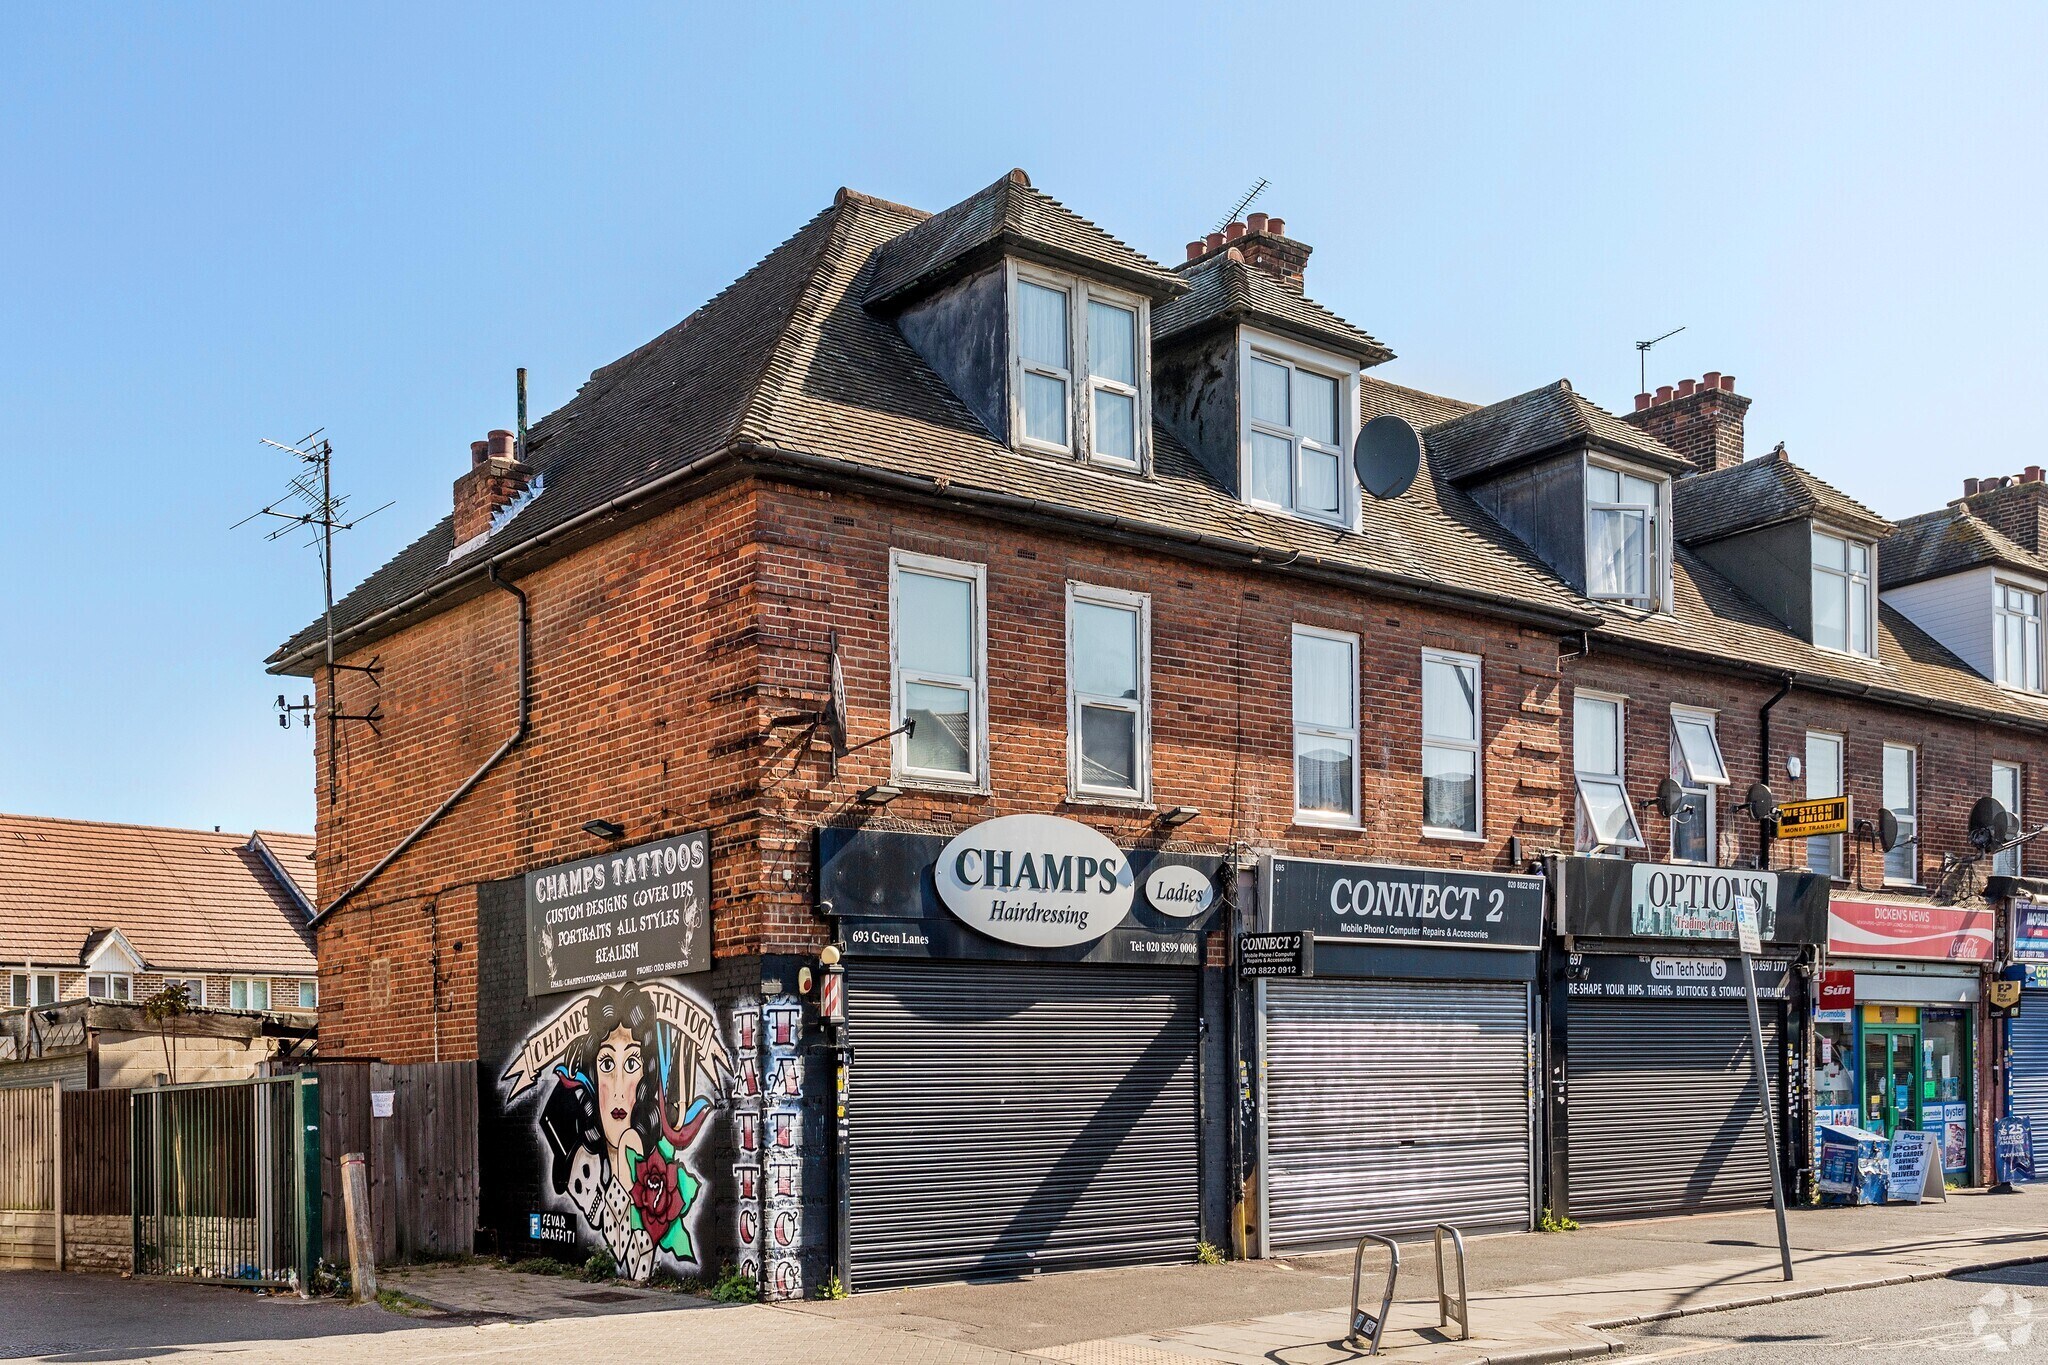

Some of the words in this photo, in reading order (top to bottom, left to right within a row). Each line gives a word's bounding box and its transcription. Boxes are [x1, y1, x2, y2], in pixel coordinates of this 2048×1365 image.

[1783, 804, 1832, 817] WESTERN
[1798, 812, 1832, 823] UNION
[1809, 823, 1840, 831] TRANSFER
[535, 863, 606, 903] CHAMPS
[611, 840, 704, 886] TATTOOS
[955, 848, 1118, 895] CHAMPS
[1275, 863, 1285, 872] 695
[1156, 881, 1203, 902] Ladies
[1507, 881, 1516, 889] 020
[546, 902, 584, 925] CUSTOM
[586, 894, 628, 917] DESIGNS
[633, 885, 669, 907] COVER
[672, 880, 694, 899] UPS
[1330, 878, 1480, 921] CONNECT
[1486, 888, 1505, 922] 2
[988, 899, 1089, 929] Hairdressing
[1874, 908, 1908, 921] DICKEN'S
[1909, 910, 1930, 923] NEWS
[558, 922, 612, 947] PORTRAITS
[617, 917, 637, 935] ALL
[640, 909, 680, 931] STYLES
[1675, 915, 1706, 931] Trading
[1708, 918, 1735, 931] Centre
[852, 931, 869, 943] 693
[871, 931, 900, 944] Green
[902, 932, 929, 944] Lanes
[1340, 922, 1362, 933] Mobile
[1364, 924, 1384, 934] Phone
[1389, 925, 1420, 936] Computer
[1422, 926, 1445, 938] Repairs
[1446, 928, 1452, 937] &
[1452, 928, 1489, 939] Accessories
[1130, 941, 1145, 952] Tel:
[1146, 941, 1160, 952] 020
[1161, 942, 1179, 952] 8599
[1180, 943, 1197, 953] 0006
[1241, 936, 1292, 951] CONNECT
[1293, 935, 1300, 949] 2
[595, 942, 640, 963] REALISM
[1569, 953, 1582, 966] 697
[1243, 967, 1257, 975] 020
[1258, 966, 1276, 975] 8822
[1278, 965, 1297, 974] 0912
[1655, 960, 1674, 976] Slim
[1675, 961, 1695, 977] Tech
[1696, 962, 1723, 978] Studio
[1774, 961, 1787, 972] 1777
[1568, 983, 1602, 995] RE-SHAPE
[1606, 983, 1625, 995] YOUR
[1627, 983, 1644, 996] HIPS,
[1647, 984, 1674, 997] THIGHS,
[1676, 985, 1708, 997] BUTTOCKS
[1711, 986, 1716, 997] &
[1755, 987, 1786, 998] ATURALLY!
[1823, 984, 1851, 995] Sun
[1818, 1010, 1846, 1019] Lycamobile
[534, 1005, 590, 1063] CHAMPS
[653, 991, 708, 1041] TATTOO
[1922, 1109, 1942, 1117] ycamobile
[1945, 1105, 1965, 1119] oyster
[2009, 1124, 2024, 1135] 25
[1894, 1143, 1923, 1151] Post
[1894, 1157, 1919, 1165] SAVINGS
[1891, 1170, 1920, 1178] DELIVERED
[542, 1213, 566, 1229] FEVAR
[540, 1228, 576, 1244] GRAFFITI
